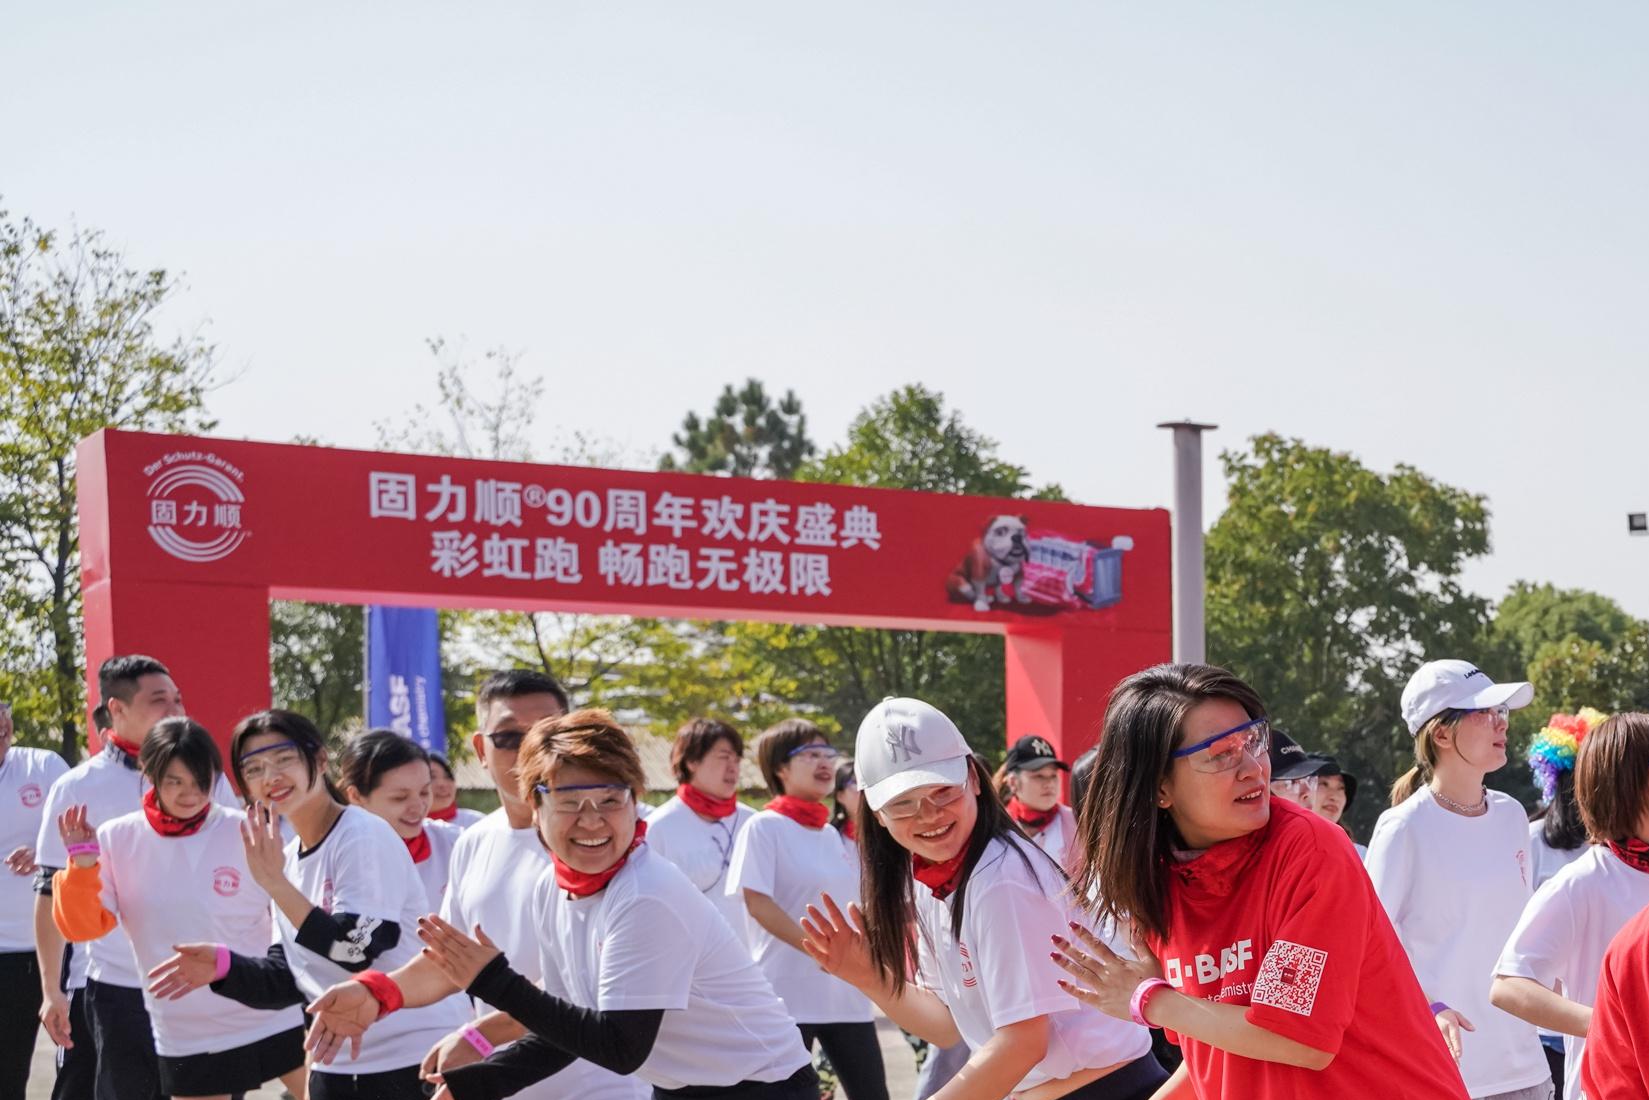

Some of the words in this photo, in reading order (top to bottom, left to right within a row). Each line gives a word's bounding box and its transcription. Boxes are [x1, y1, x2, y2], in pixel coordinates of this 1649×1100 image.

[151, 499, 242, 529] 固力顺
[430, 529, 583, 584] 彩虹跑
[597, 538, 832, 597] 畅跑无极限
[388, 673, 413, 739] ASF
